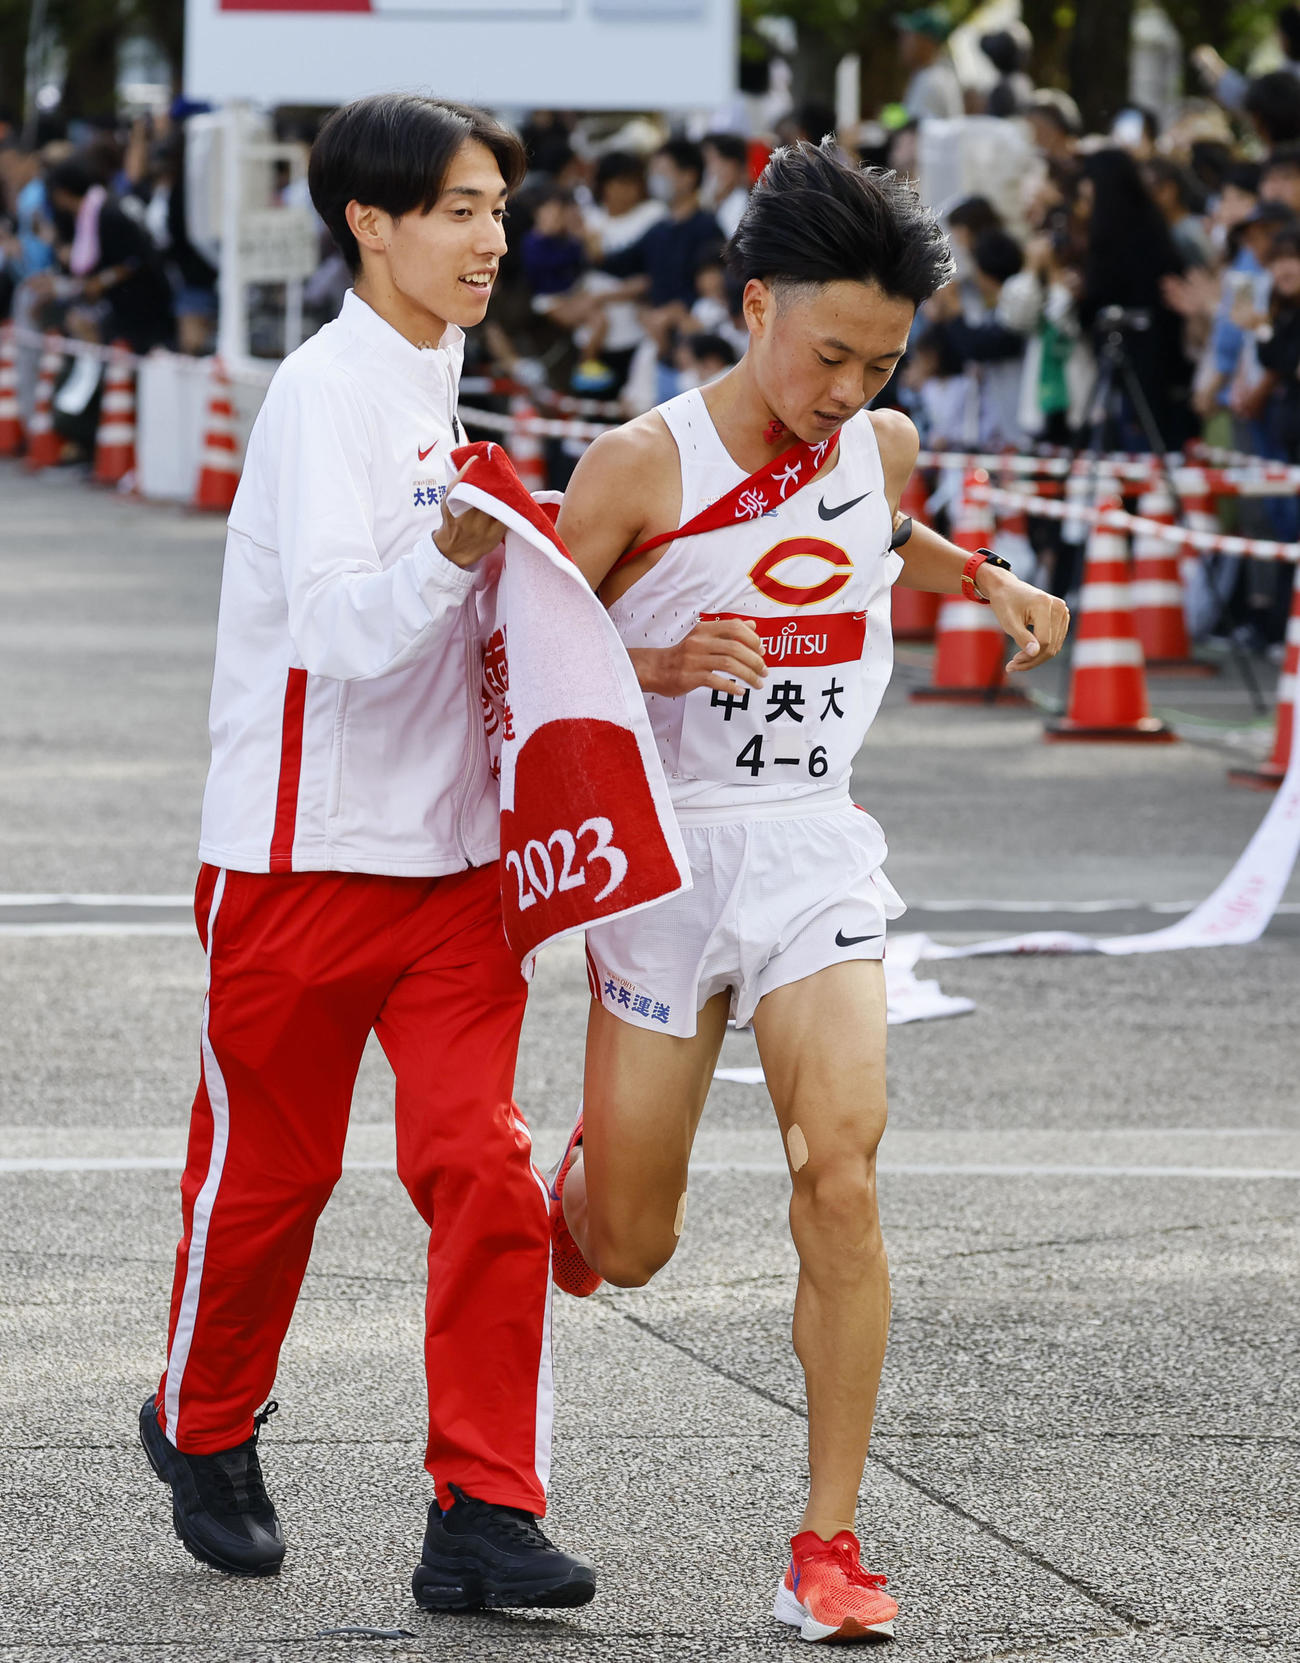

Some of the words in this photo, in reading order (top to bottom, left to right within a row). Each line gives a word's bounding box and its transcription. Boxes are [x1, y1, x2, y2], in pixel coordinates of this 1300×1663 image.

[760, 622, 829, 662] FUJITSU
[710, 677, 845, 724] 中央大
[505, 816, 629, 912] 2023
[604, 979, 671, 1024] 大矢運送
